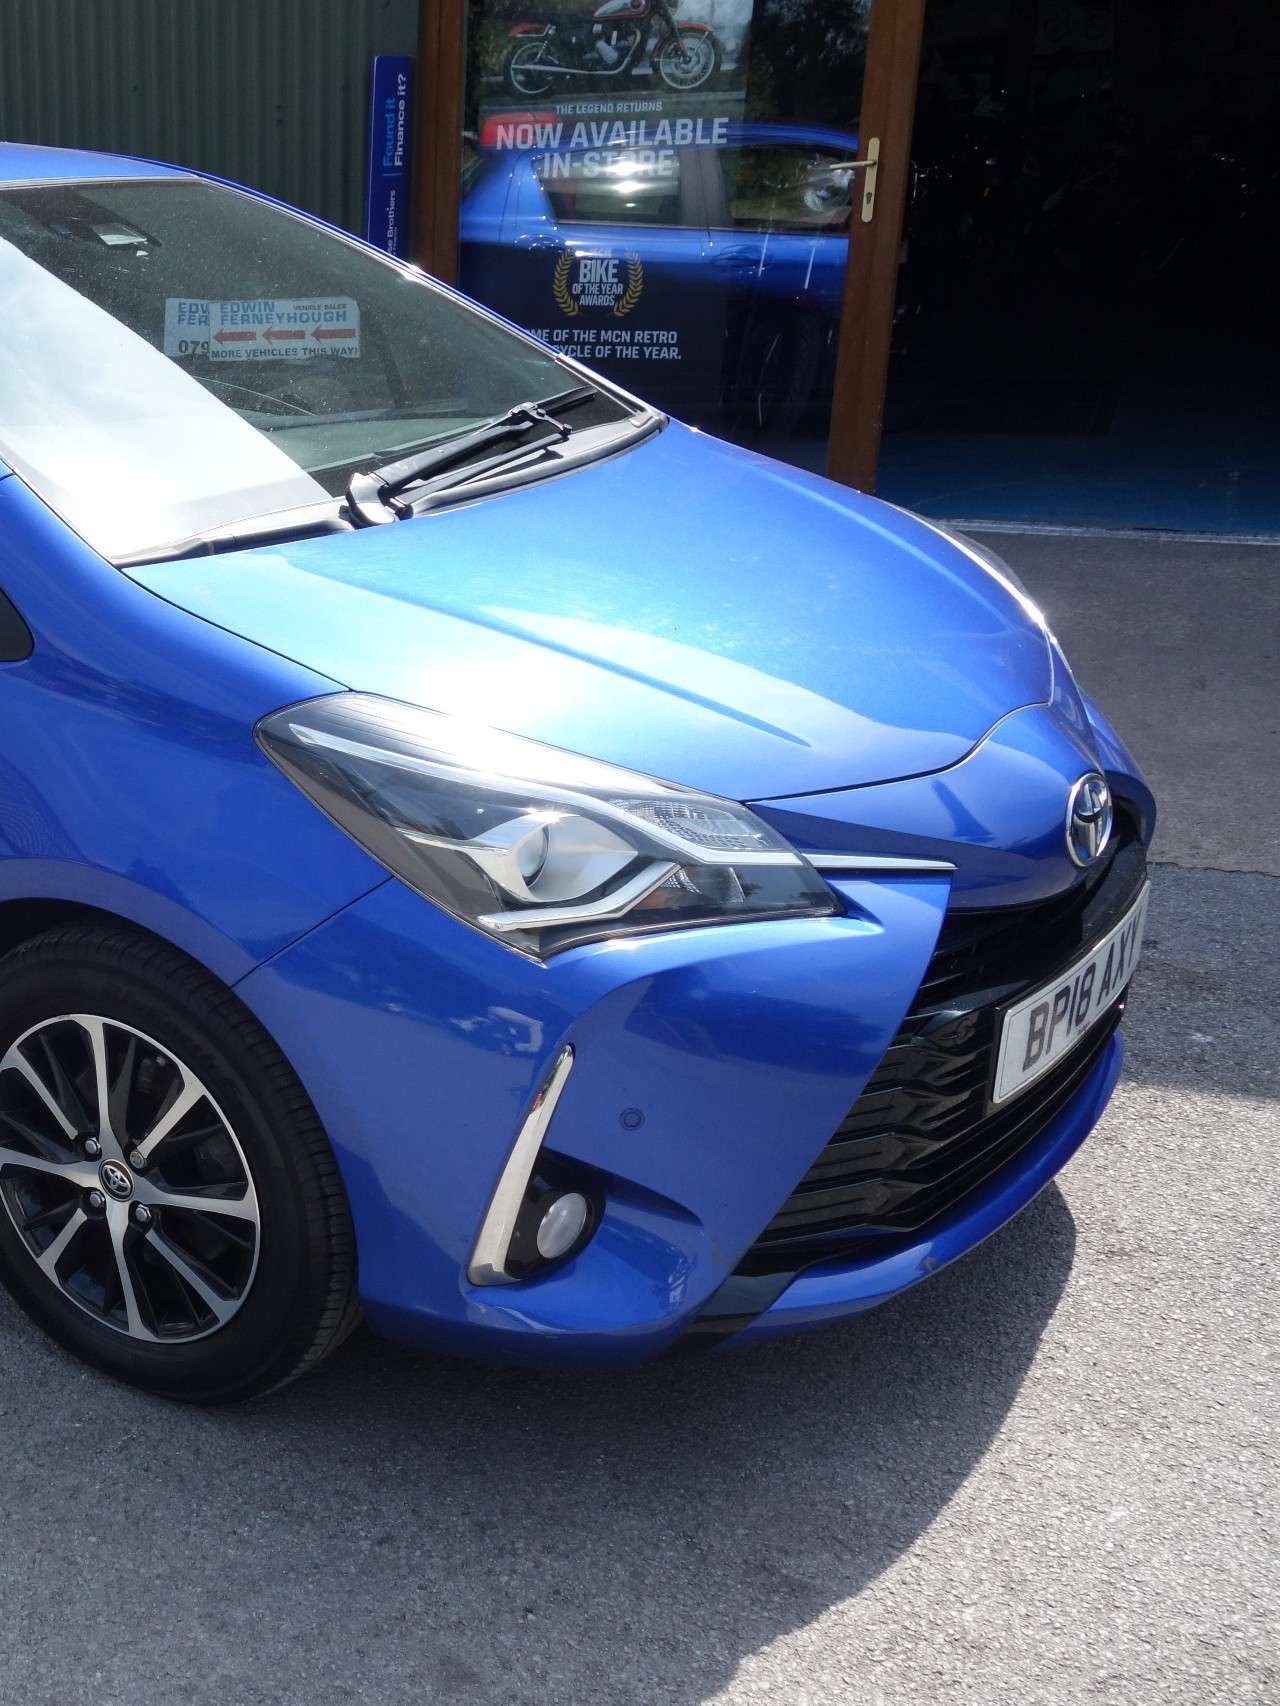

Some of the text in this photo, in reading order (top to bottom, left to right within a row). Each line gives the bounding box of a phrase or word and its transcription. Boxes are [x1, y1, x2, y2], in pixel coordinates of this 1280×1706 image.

[556, 101, 663, 115] THE LEGEND RETURNS
[394, 73, 407, 167] Finance it?
[383, 97, 396, 167] Found it
[496, 117, 729, 150] NOW AVAILABLE
[579, 259, 619, 283] BIKE
[572, 283, 624, 295] OF THE YEAR
[220, 301, 275, 314] EDWIN
[579, 295, 615, 306] AWARDS
[221, 310, 347, 325] FERNEYHOUGH
[553, 329, 569, 341] OF
[572, 329, 597, 342] THE
[601, 330, 631, 343] MCN
[634, 330, 678, 344] RETRO
[211, 350, 241, 358] MORE
[245, 347, 298, 357] VEHICLES
[301, 347, 327, 356] THIS
[595, 345, 613, 358] OF
[615, 346, 641, 359] THE
[643, 347, 682, 360] YEAR.
[1023, 961, 1097, 1072] BP18
